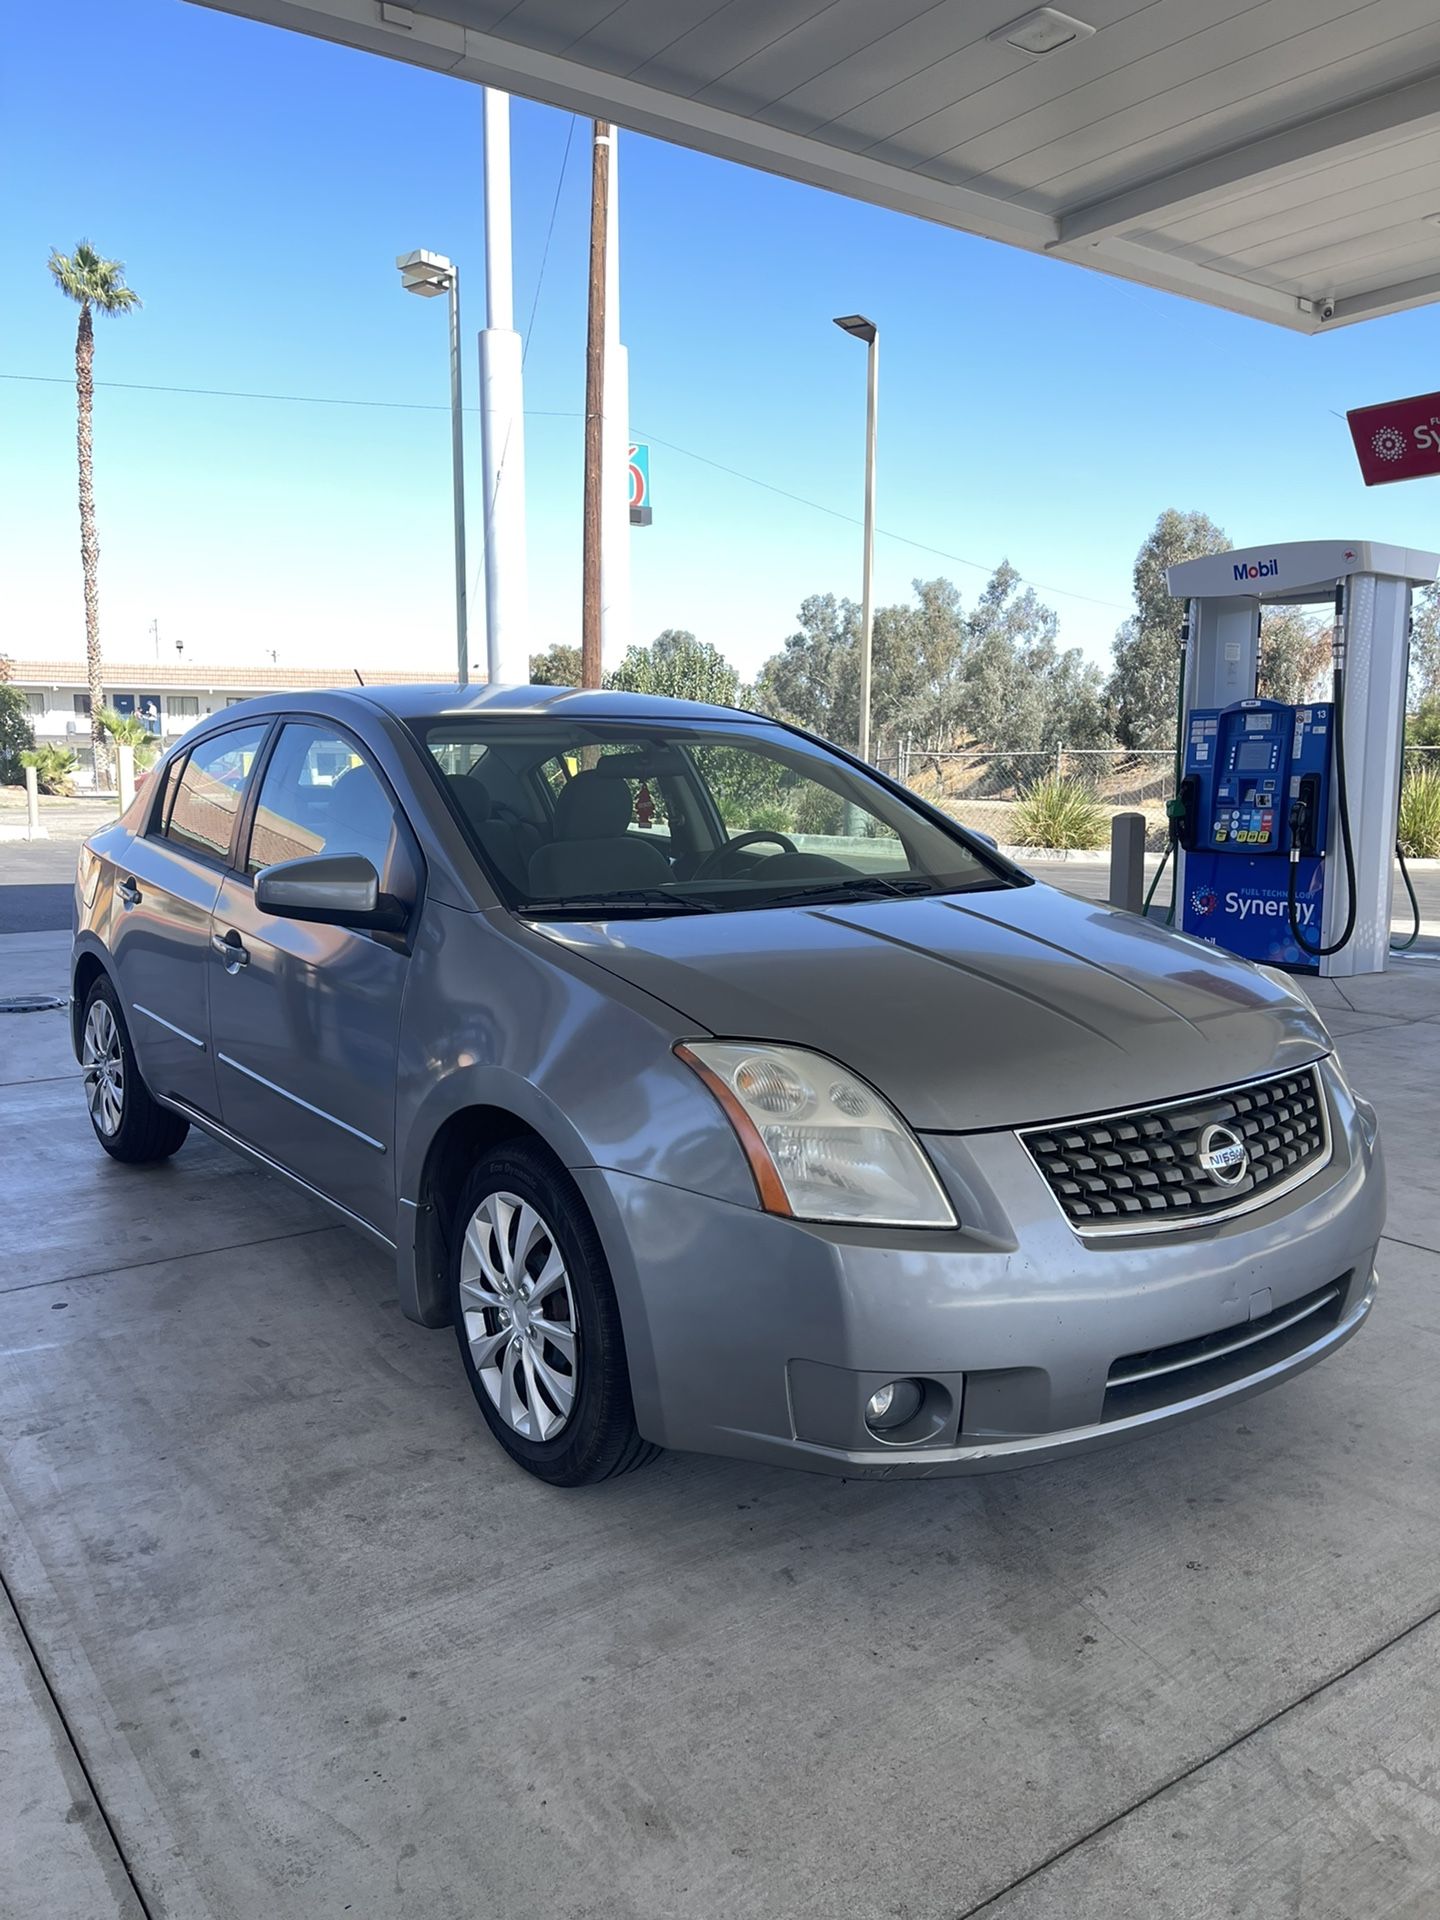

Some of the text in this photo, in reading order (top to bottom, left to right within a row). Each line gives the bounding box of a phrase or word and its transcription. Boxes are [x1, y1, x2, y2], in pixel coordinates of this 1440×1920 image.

[1233, 559, 1279, 581] Mobil
[1316, 710, 1327, 719] 13
[1241, 888, 1315, 900] FUEL TECHNLOGY
